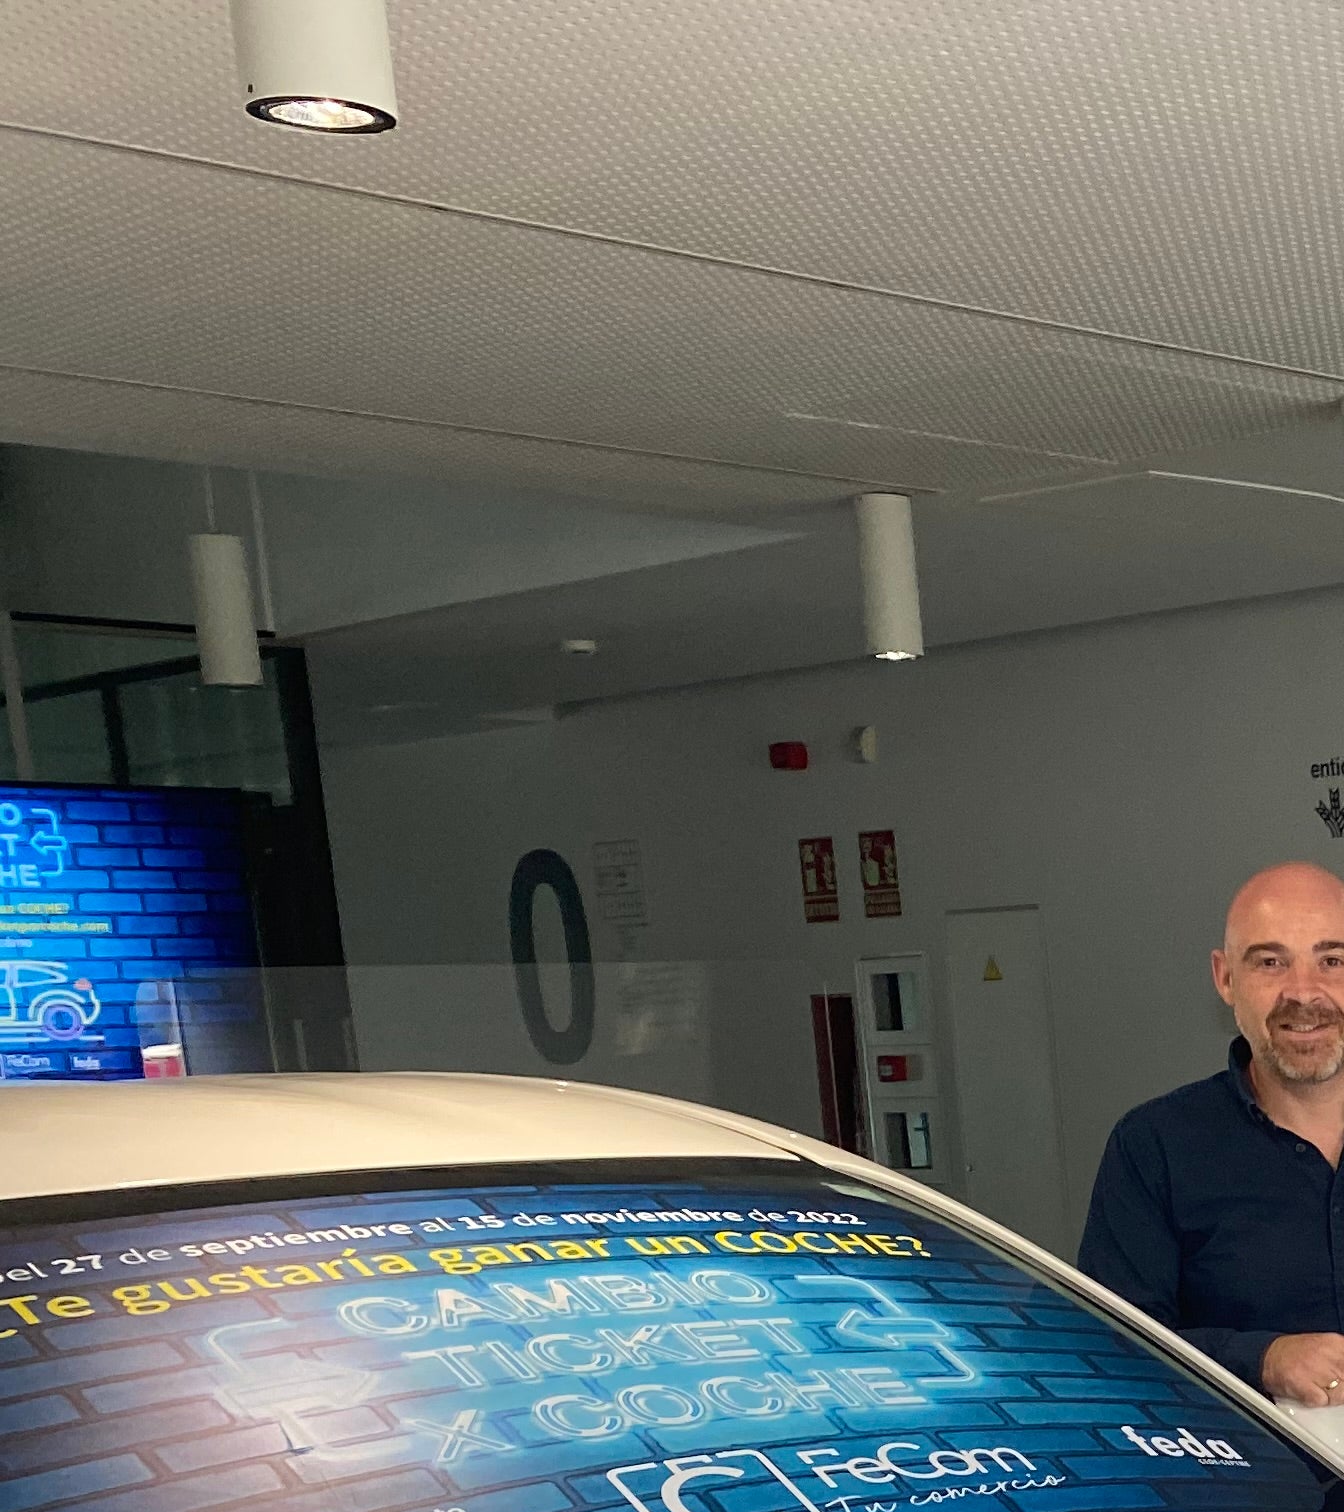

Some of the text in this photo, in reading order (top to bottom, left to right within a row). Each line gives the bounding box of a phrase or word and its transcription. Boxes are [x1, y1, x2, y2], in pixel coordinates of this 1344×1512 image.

[50, 1255, 104, 1276] 27
[119, 1245, 173, 1265] de
[180, 1221, 414, 1259] septiembre
[420, 1216, 457, 1235] al
[461, 1215, 506, 1231] 15
[513, 1212, 556, 1228] de
[561, 1208, 746, 1225] noviembre
[748, 1209, 786, 1222] de
[787, 1210, 868, 1227] 2022
[112, 1248, 416, 1316] gustaría
[428, 1235, 610, 1276] ganar
[624, 1234, 710, 1255] un
[713, 1231, 932, 1259] COCHE?
[335, 1268, 775, 1338] CAMBIO
[402, 1316, 805, 1391] TICKET
[408, 1366, 930, 1464] X COCHE
[1120, 1425, 1243, 1460] feda
[796, 1442, 1038, 1489] FeCom
[910, 1473, 1066, 1506] comercio
